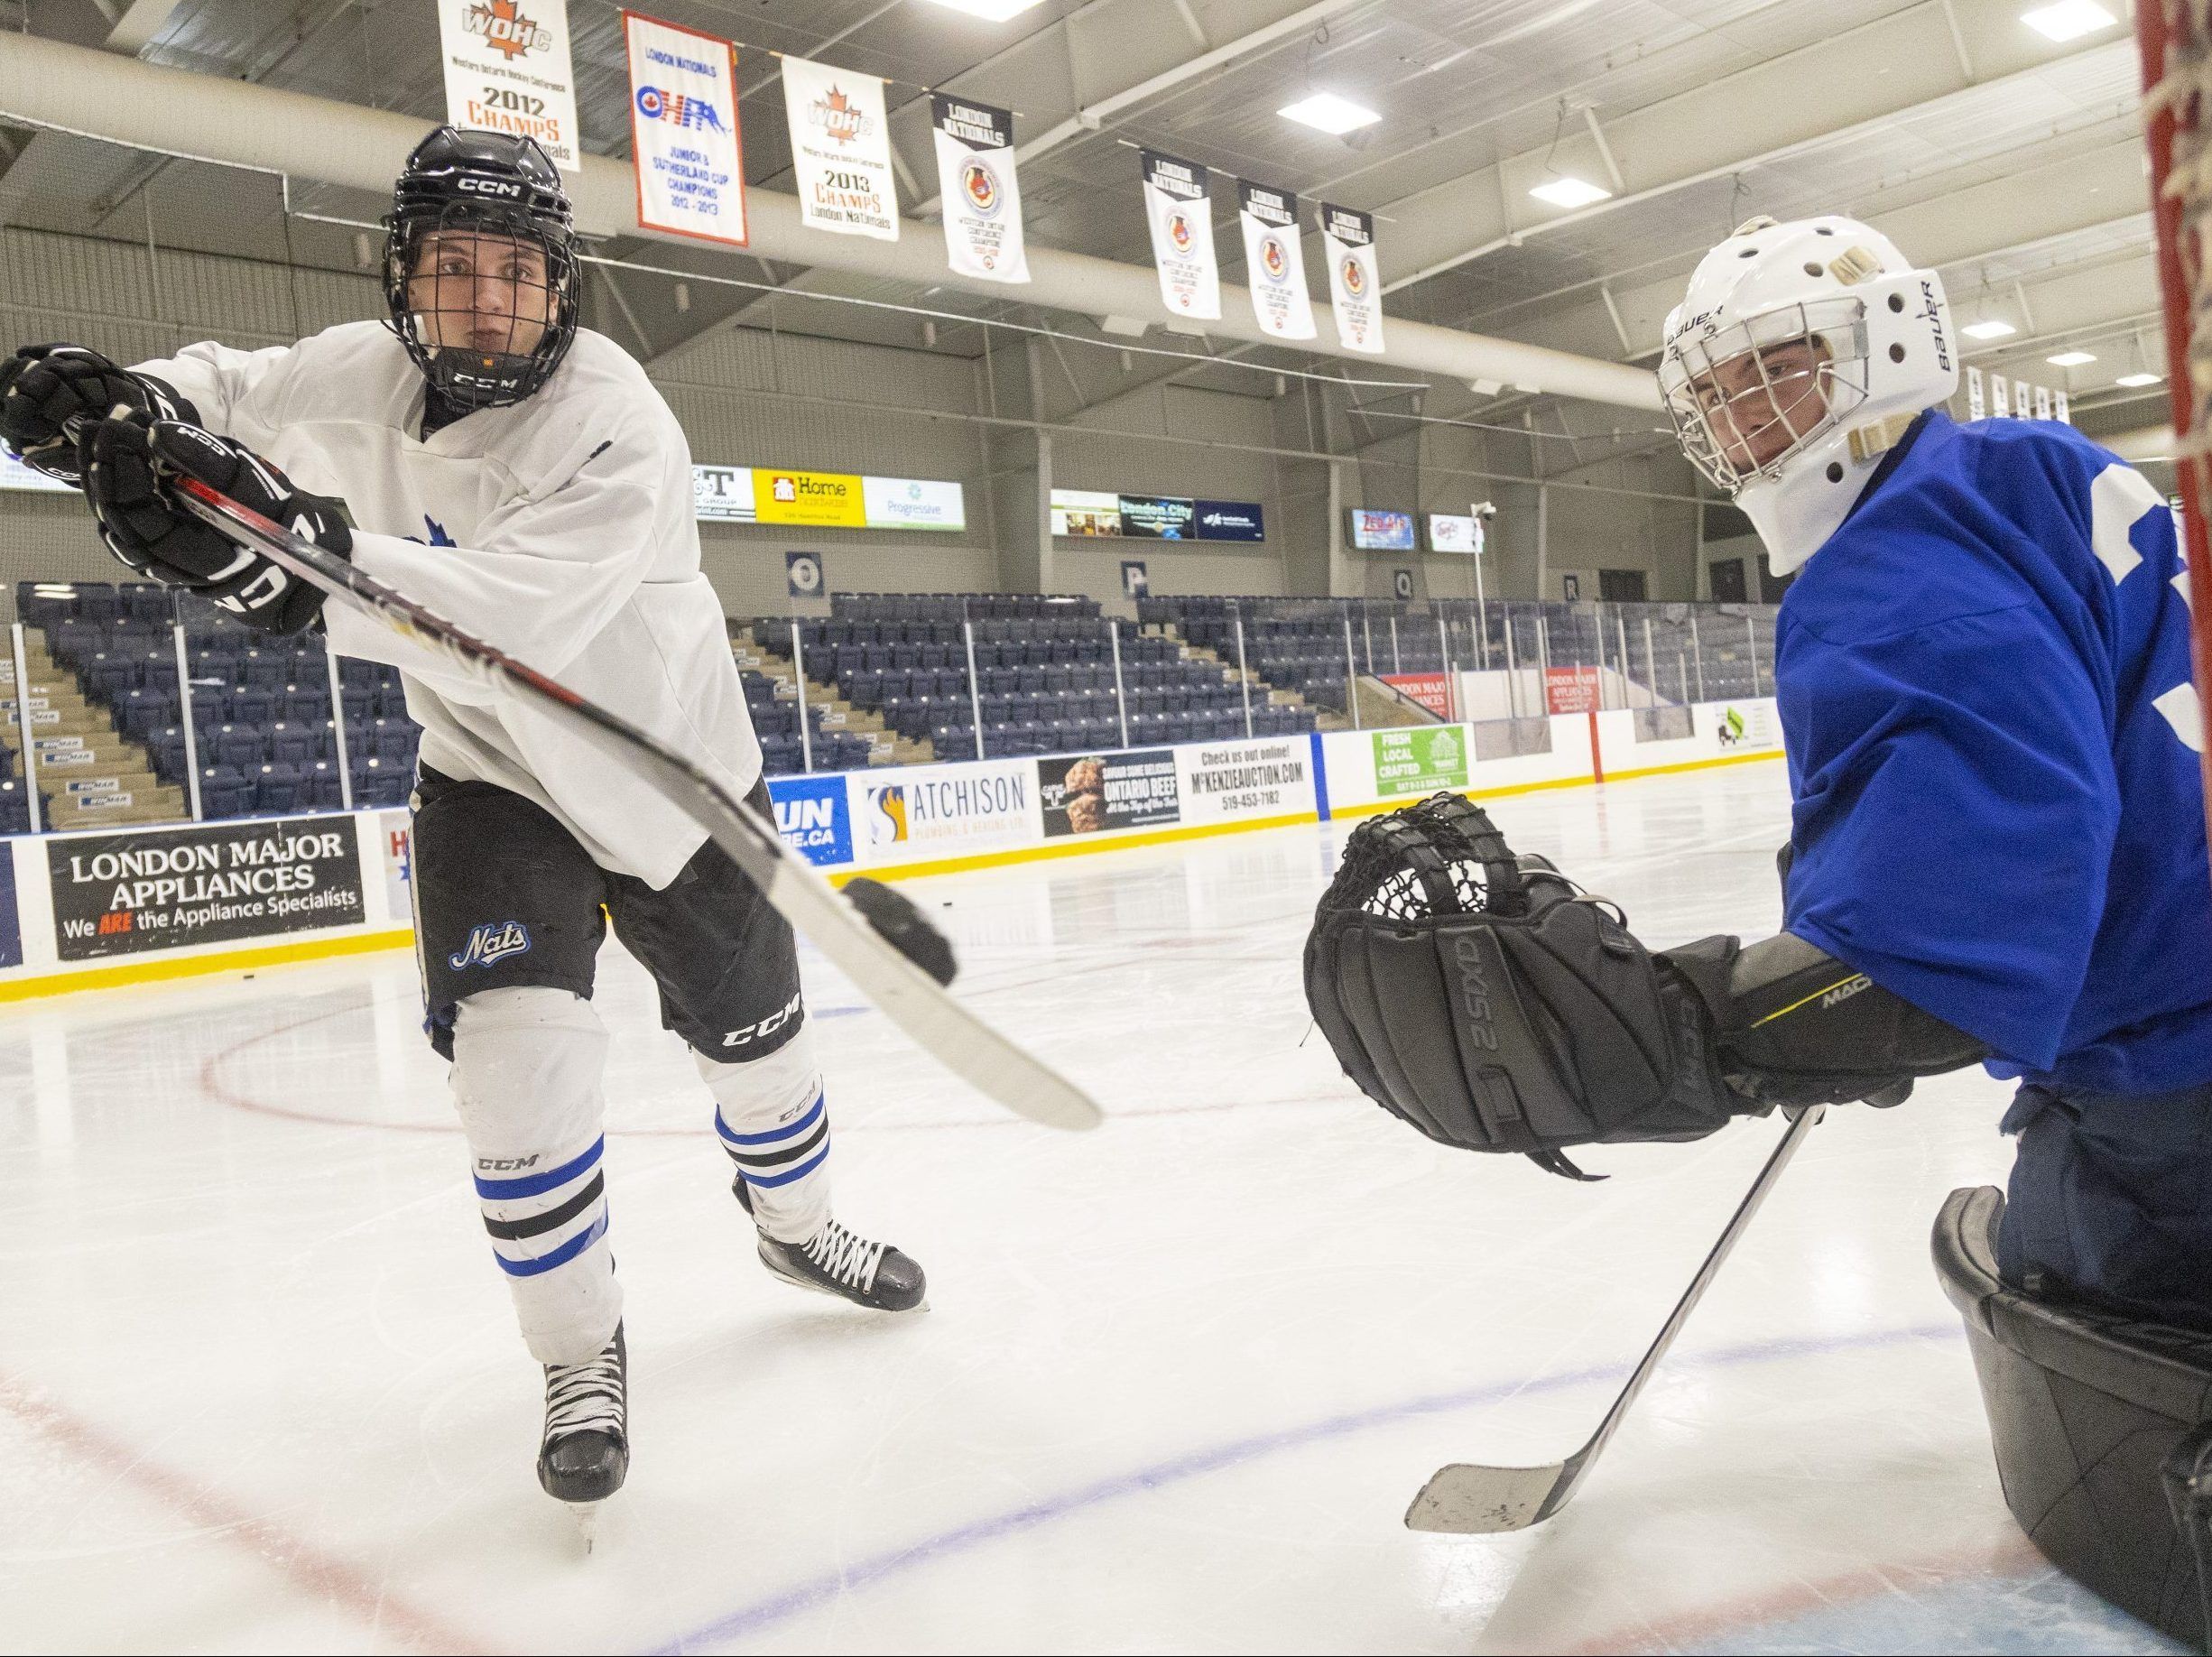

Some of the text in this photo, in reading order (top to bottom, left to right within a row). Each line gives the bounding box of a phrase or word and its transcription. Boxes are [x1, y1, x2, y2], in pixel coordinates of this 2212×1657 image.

[461, 8, 552, 52] WOHC
[645, 45, 717, 78] LONDON NATIONALS
[483, 87, 546, 119] 2012
[467, 100, 560, 143] CHAMPS
[670, 146, 701, 162] JUNIOR
[652, 156, 729, 186] SUTHERLAND CUP
[825, 170, 870, 192] 2013
[458, 178, 521, 198] CCM
[668, 178, 718, 200] CHAMPIONS
[815, 182, 881, 214] CHAMPS
[697, 199, 718, 216] 2013
[810, 203, 891, 229] London Nationals
[797, 476, 847, 496] Home
[887, 499, 941, 516] Progressive
[1382, 732, 1411, 746] FRESH
[1201, 744, 1290, 766] Check us out online!
[1383, 747, 1414, 763] LOCAL
[1378, 762, 1421, 779] CRAFTED
[913, 774, 1026, 821] ATCHISON
[1104, 775, 1177, 802] ONTARIO BEEF
[1222, 790, 1280, 810] 519-453-7182
[773, 797, 834, 833] UN
[70, 832, 345, 883] LONDON MAJOR
[109, 864, 316, 911] APPLIANCES
[63, 887, 356, 939] We ARE the Appliance Specialists
[451, 922, 527, 968] Nats
[1821, 976, 1874, 1009] MAC
[721, 991, 801, 1047] CCM
[477, 1153, 540, 1171] CCM
